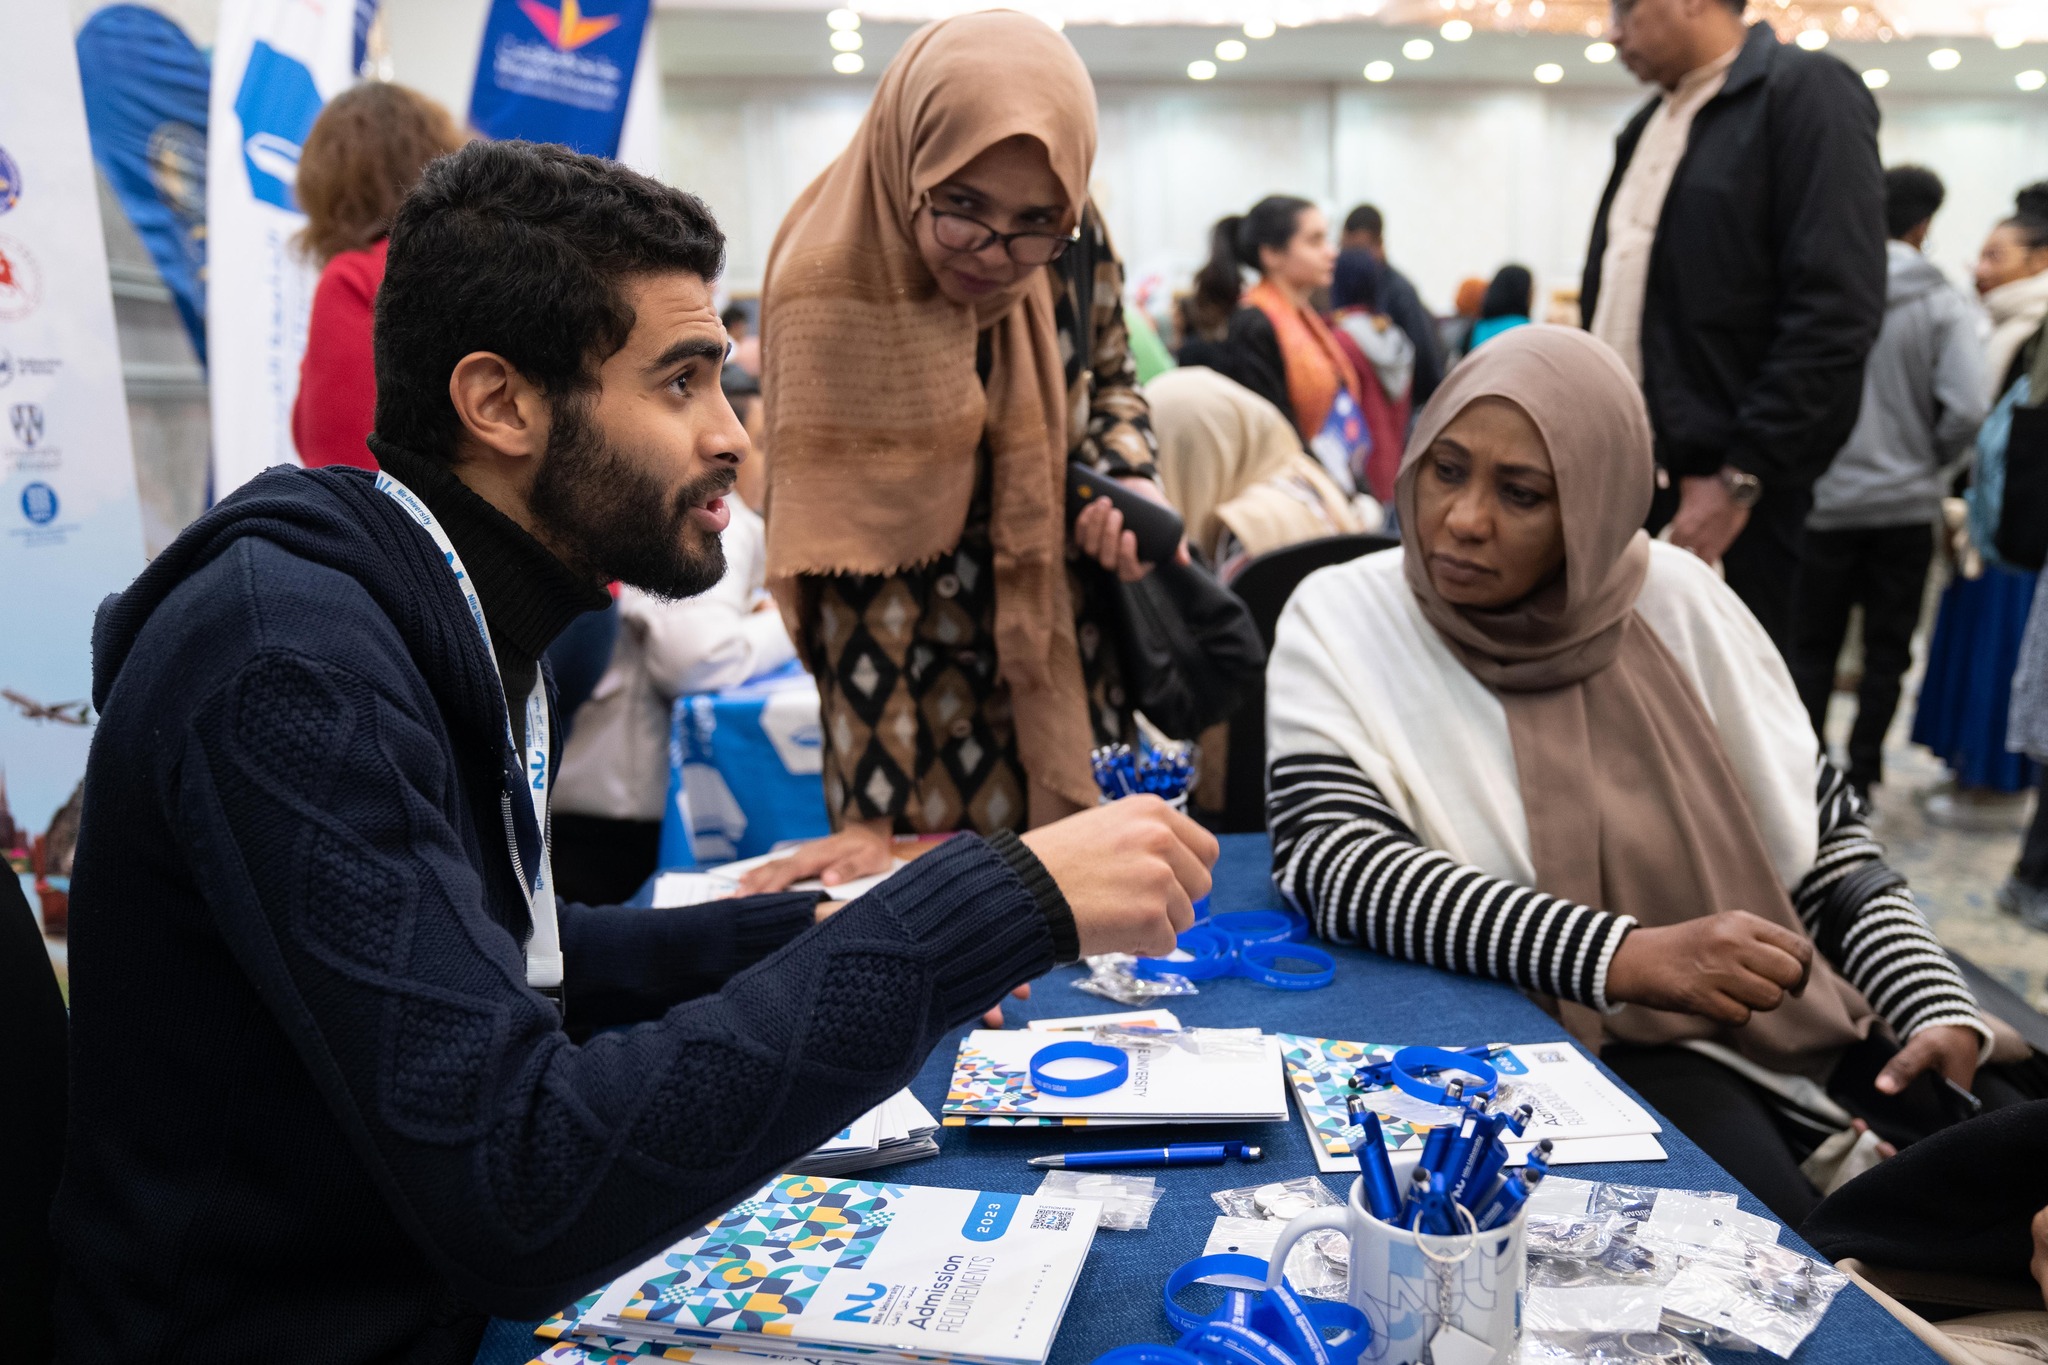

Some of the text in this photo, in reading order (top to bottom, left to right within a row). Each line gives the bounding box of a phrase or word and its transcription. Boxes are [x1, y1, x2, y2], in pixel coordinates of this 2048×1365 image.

[405, 493, 432, 526] University
[467, 593, 492, 651] Nile Universit
[530, 750, 546, 789] NU
[1133, 1053, 1150, 1097] UNIVERSITY
[976, 1202, 1001, 1235] 2023
[832, 1281, 889, 1324] NU
[871, 1284, 903, 1325] Nile University
[907, 1254, 965, 1331] Admission
[935, 1255, 995, 1334] REQUIREMENTS
